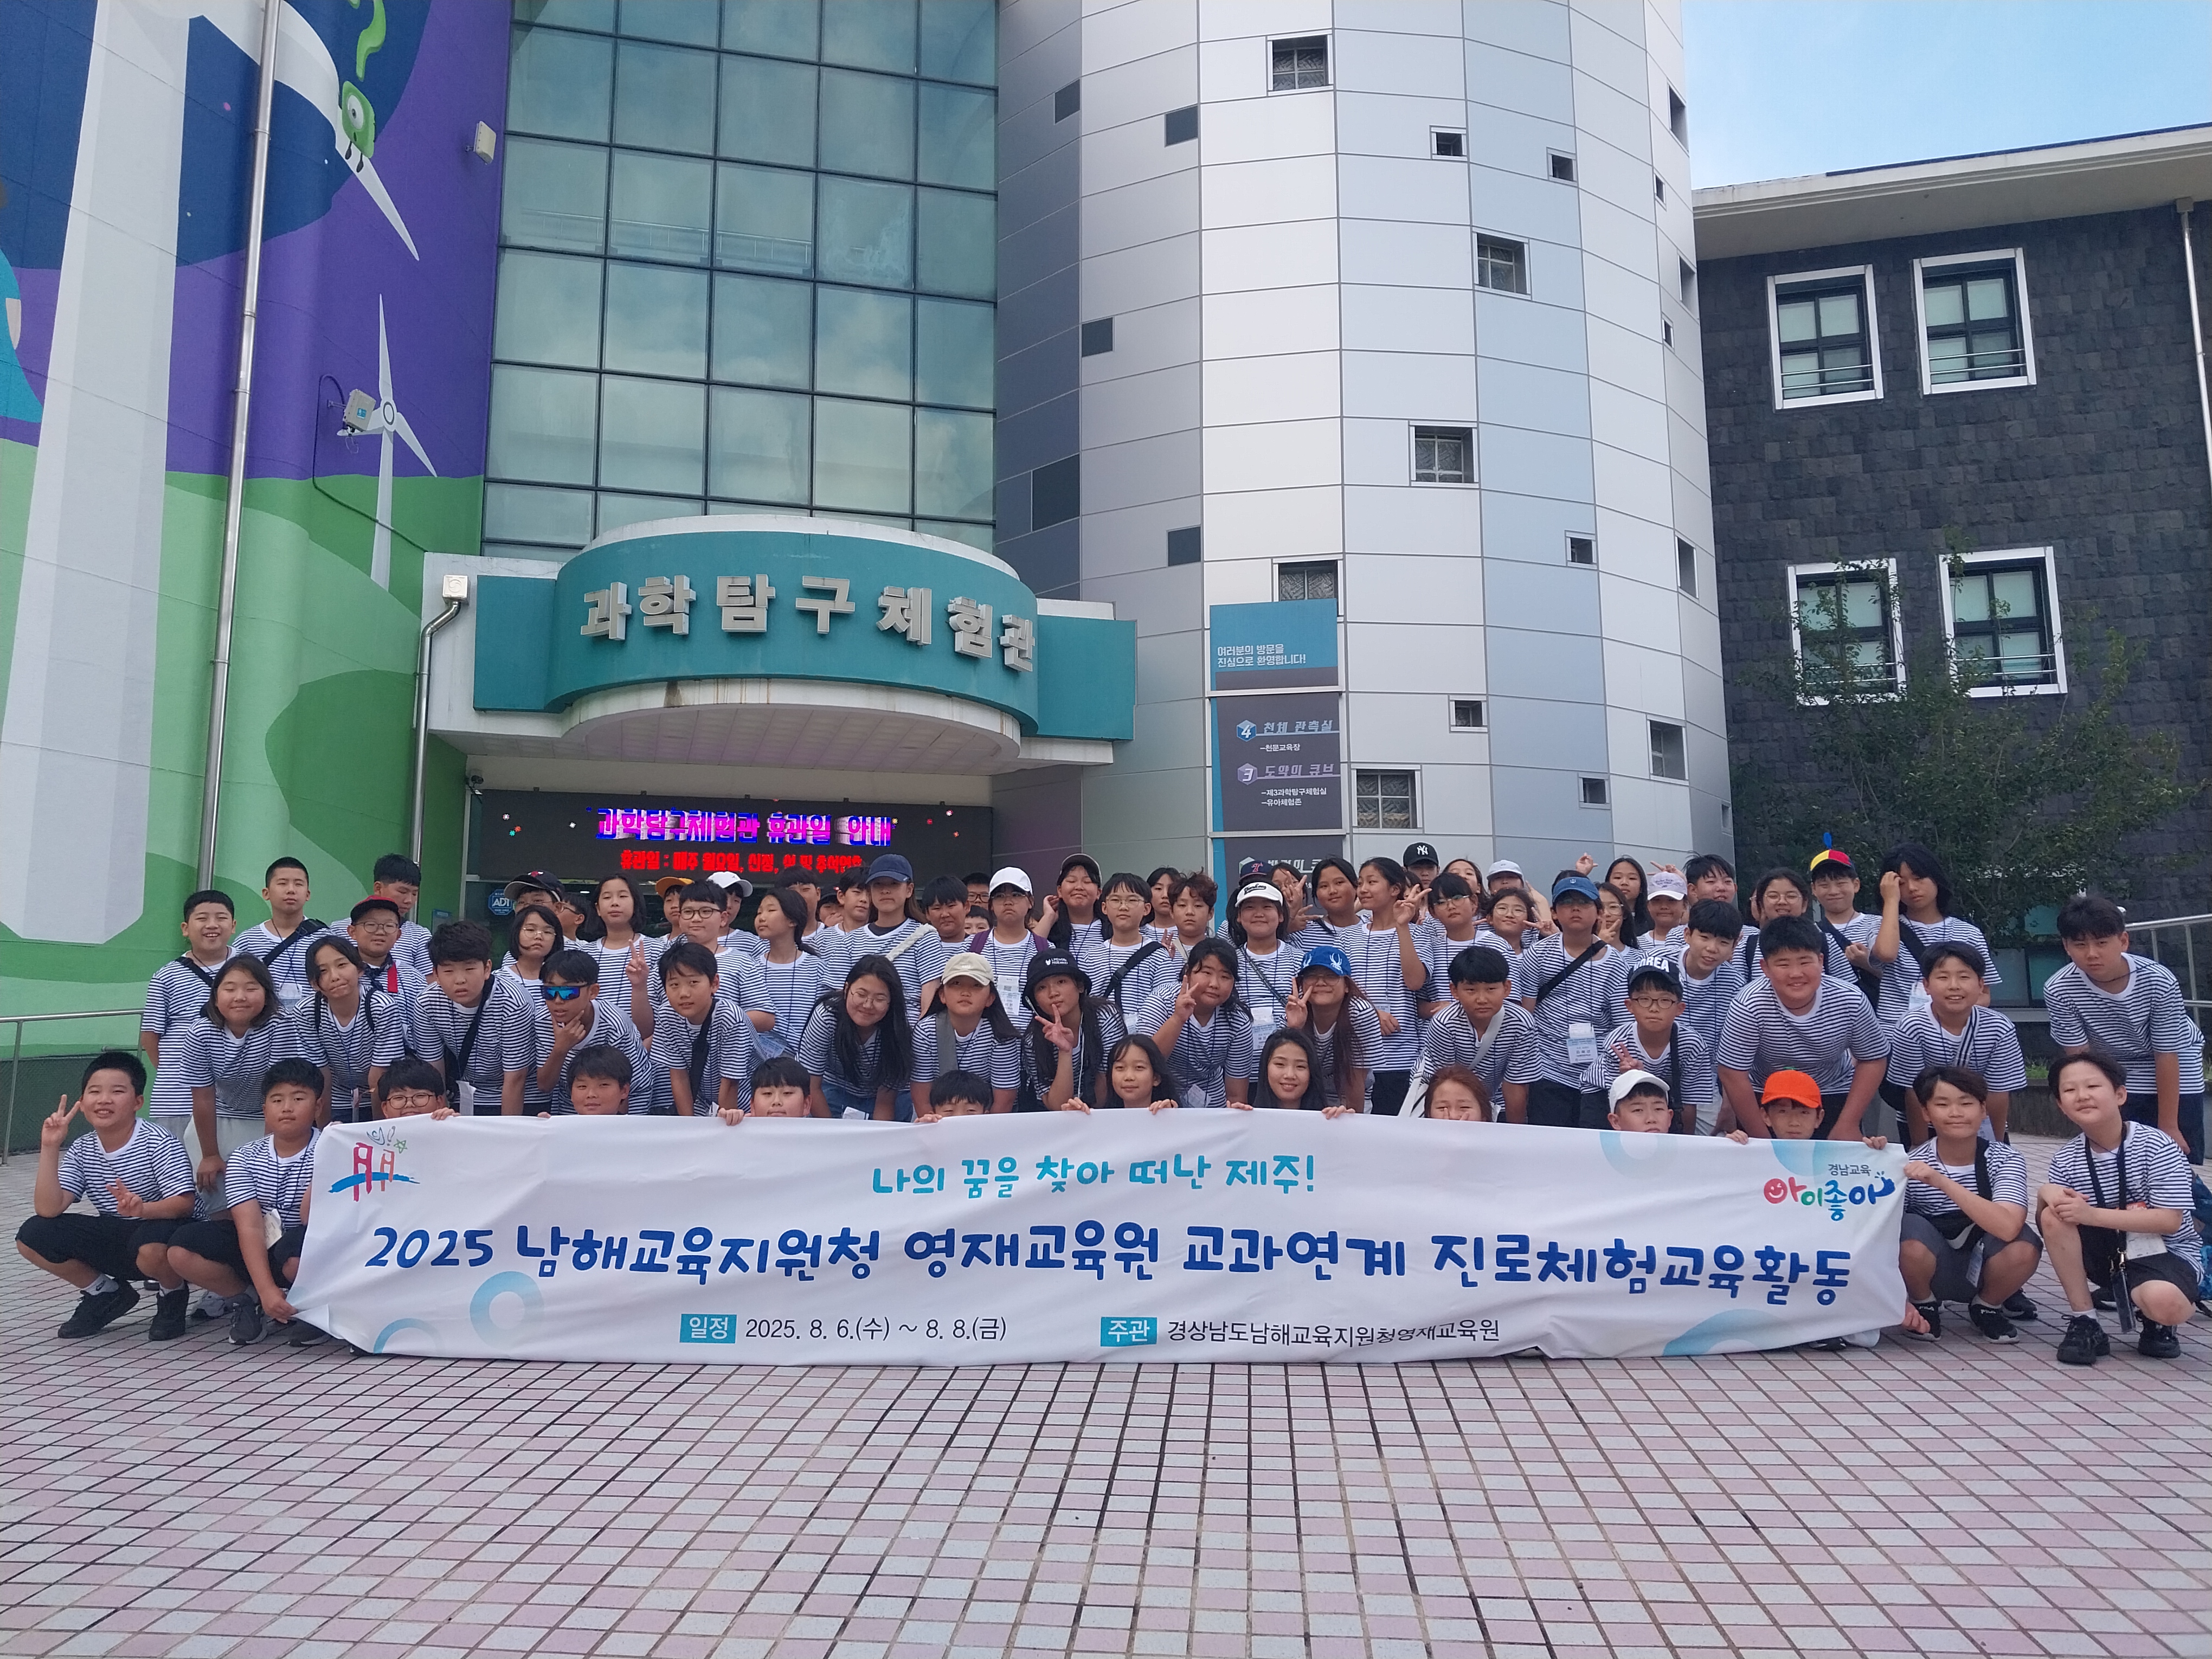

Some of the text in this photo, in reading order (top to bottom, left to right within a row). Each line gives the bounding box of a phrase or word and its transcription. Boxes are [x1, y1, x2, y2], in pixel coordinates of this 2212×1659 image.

[581, 574, 1035, 672] 과학탐구체험관
[1218, 644, 1284, 657] 여러분의 방문을
[1218, 654, 1306, 667] 진심으로 환영합니다!
[1241, 720, 1333, 738] 4 천체 관측실
[1242, 763, 1334, 781] 3 도약의 큐브
[596, 808, 891, 846] 과학탐구체험관 휴관일 안내
[621, 850, 660, 870] 휴관일
[492, 897, 510, 906] ADT
[872, 1153, 1315, 1199] 나의 꿈을 찾아 떠난 제주!
[1828, 1163, 1872, 1176] 경남교육
[1764, 1176, 1895, 1221] 아이좋아
[365, 1219, 1852, 1306] 2025 남해교육지원청 영재교육원 교과연계 진로체험교육활동
[689, 1316, 729, 1340] 일정
[745, 1319, 800, 1340] 2025.
[809, 1319, 827, 1340] 8.
[837, 1316, 890, 1341] 6.(수)
[925, 1319, 943, 1340] 8.
[952, 1316, 1007, 1341] 8.(금)
[1107, 1319, 1150, 1342] 주관
